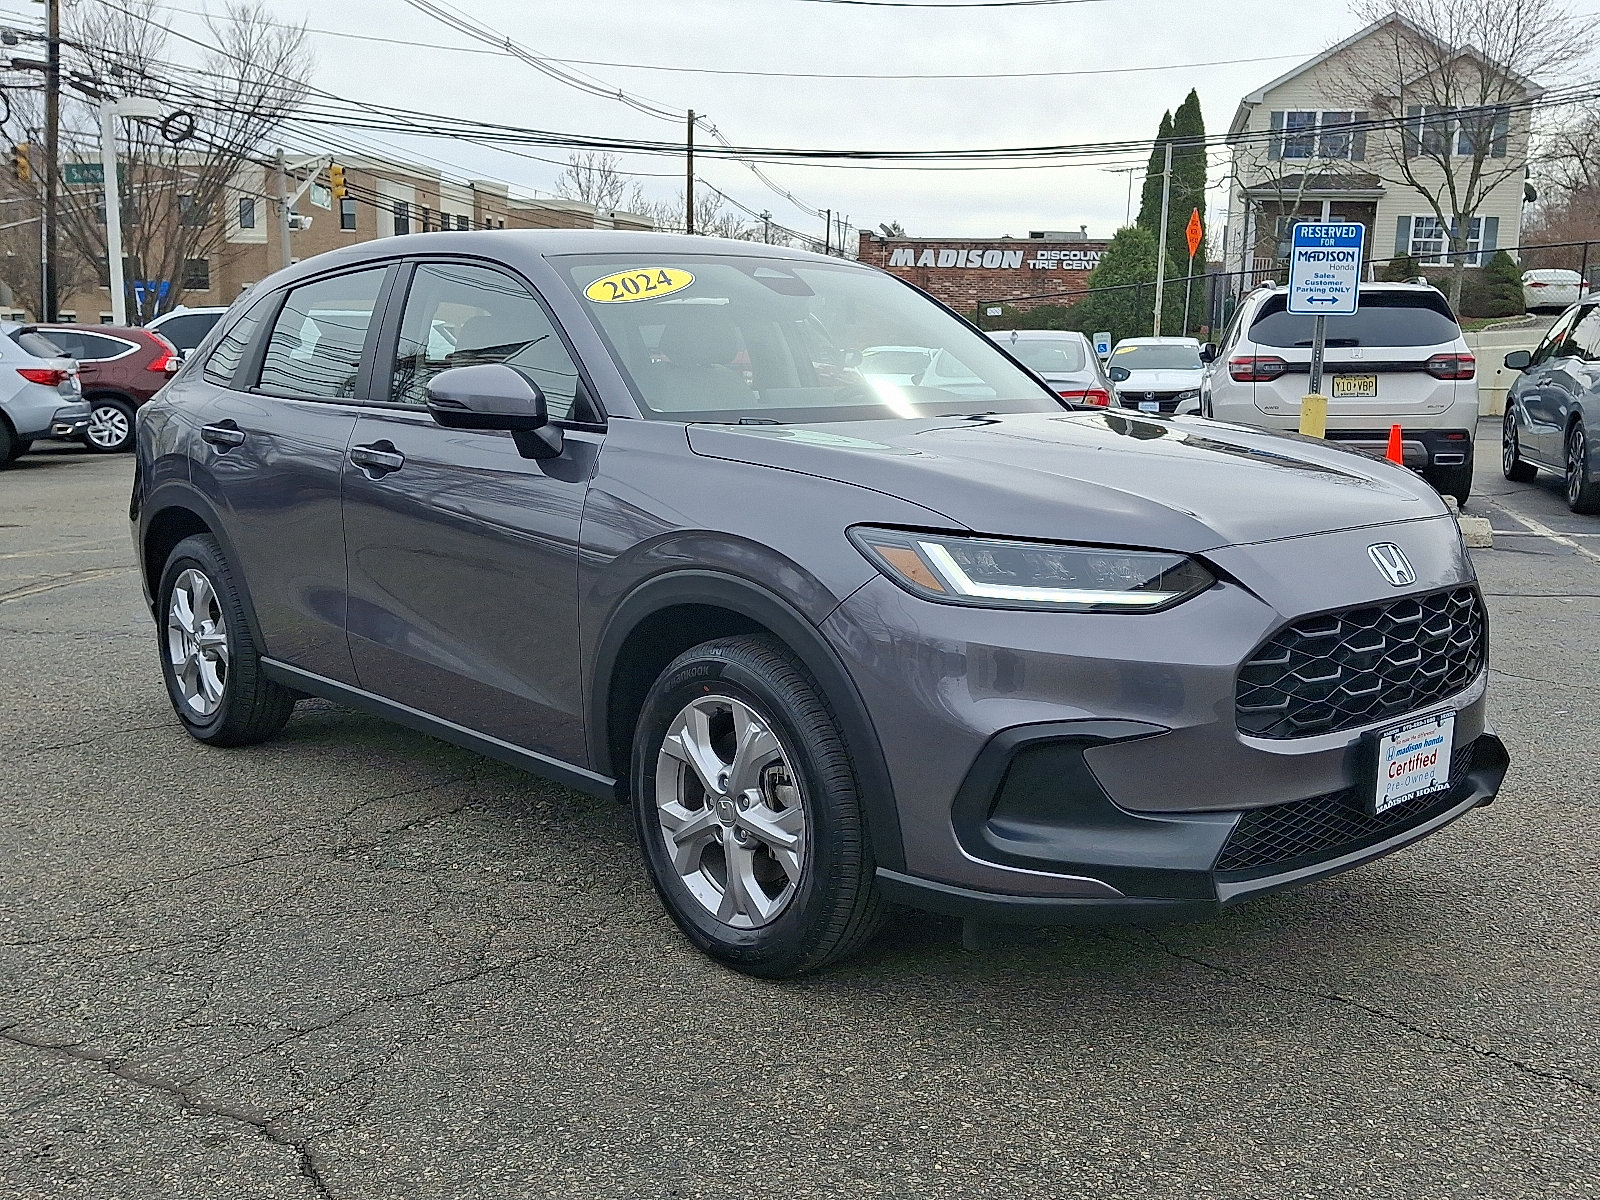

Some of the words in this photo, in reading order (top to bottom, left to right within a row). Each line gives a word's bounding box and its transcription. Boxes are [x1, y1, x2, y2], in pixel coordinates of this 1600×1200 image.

[1301, 227, 1356, 237] RESERVED
[889, 248, 1024, 269] MADISON
[1027, 260, 1058, 270] TIRE
[1298, 251, 1355, 262] MADISON
[602, 269, 673, 300] 2024
[1296, 286, 1327, 294] Parking
[1396, 743, 1422, 756] madison
[1424, 735, 1443, 748] honda
[1388, 748, 1438, 779] Certified
[1386, 768, 1435, 793] Pre-Owned
[1376, 793, 1414, 814] MADISON
[1416, 783, 1450, 798] HONDA
